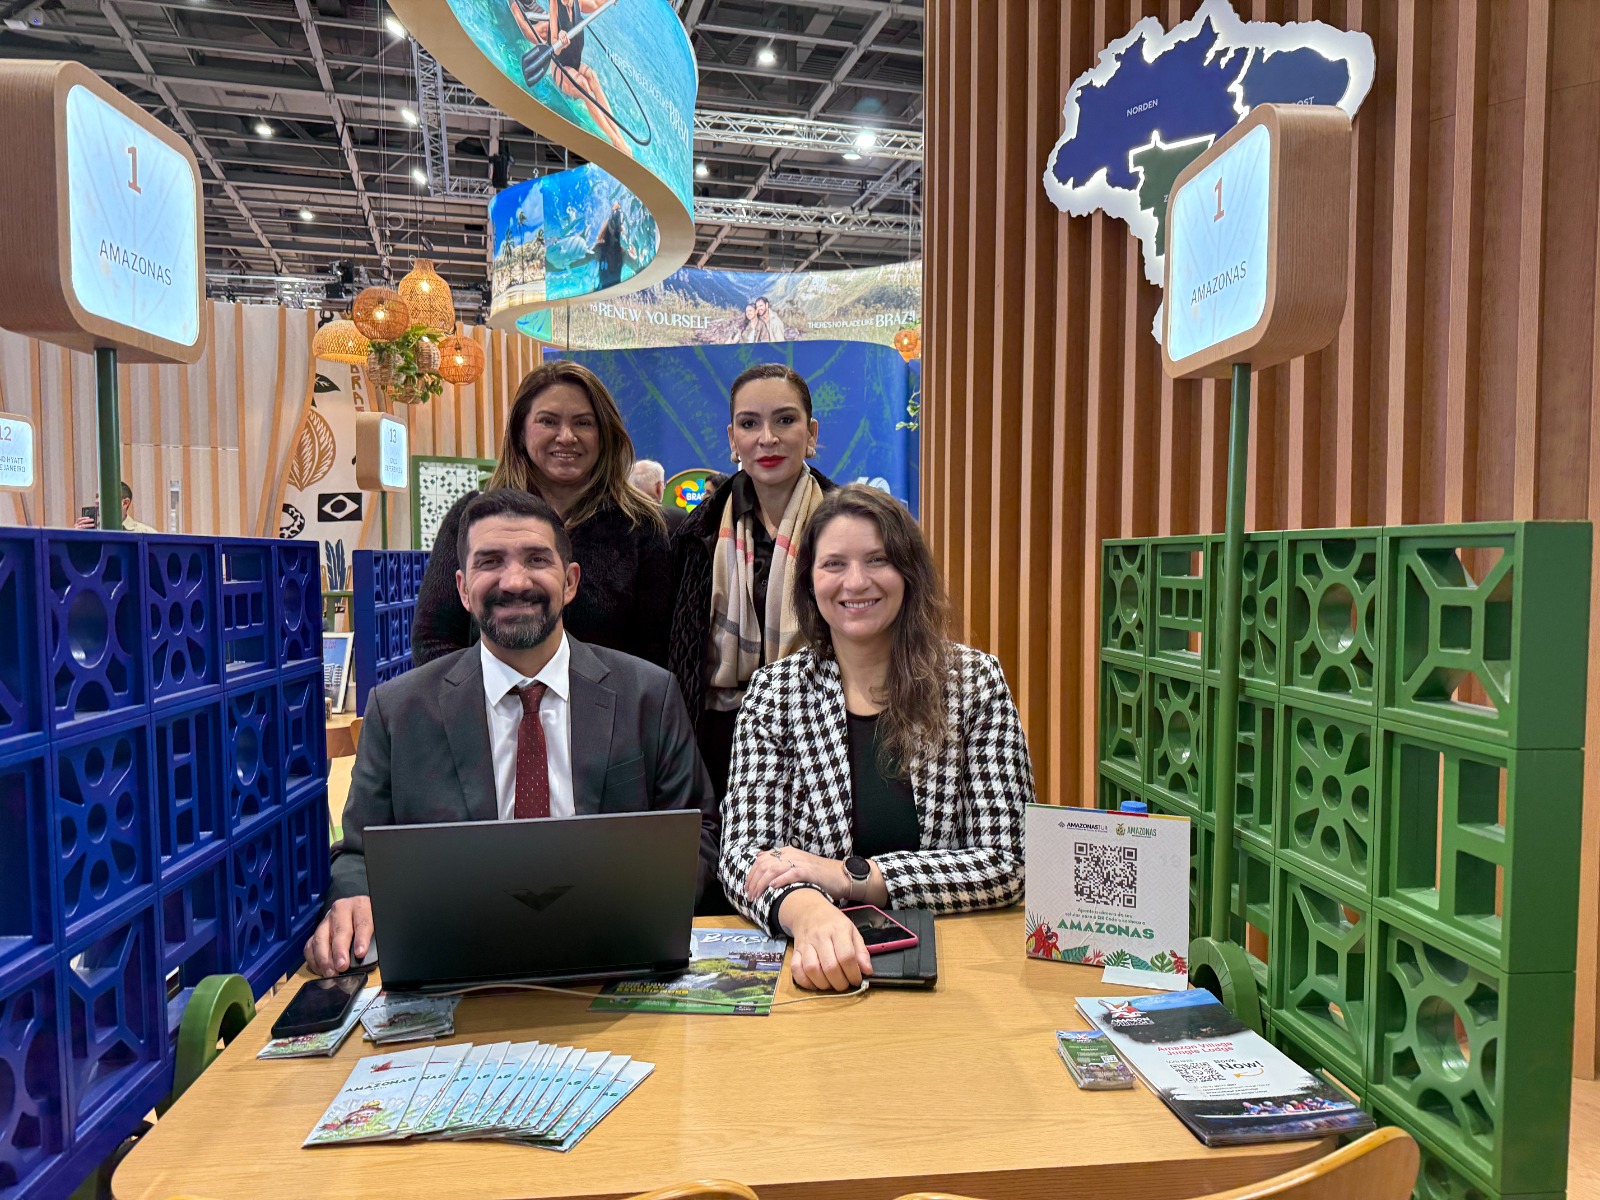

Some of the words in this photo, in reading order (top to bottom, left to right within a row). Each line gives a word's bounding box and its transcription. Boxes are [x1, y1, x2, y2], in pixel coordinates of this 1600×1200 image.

[1126, 98, 1159, 117] NORDEN
[127, 146, 142, 195] 1
[1213, 176, 1225, 223] 1
[99, 238, 172, 286] AMAZONAS
[1190, 260, 1247, 306] AMAZONAS
[598, 302, 642, 322] RENEW
[645, 309, 712, 329] YOURSELF
[842, 320, 861, 328] PLACE
[861, 318, 874, 326] LIKE
[389, 427, 397, 444] 13
[6, 456, 24, 465] HYATT
[1127, 826, 1157, 837] AMAZONAS
[1057, 918, 1155, 940] AMAZONAS
[1157, 1044, 1198, 1052] Amazon
[1198, 1041, 1234, 1050] Village
[1167, 1048, 1200, 1056] Jungle
[1218, 1060, 1264, 1071] Now!
[345, 1075, 417, 1093] AMAZONAS
